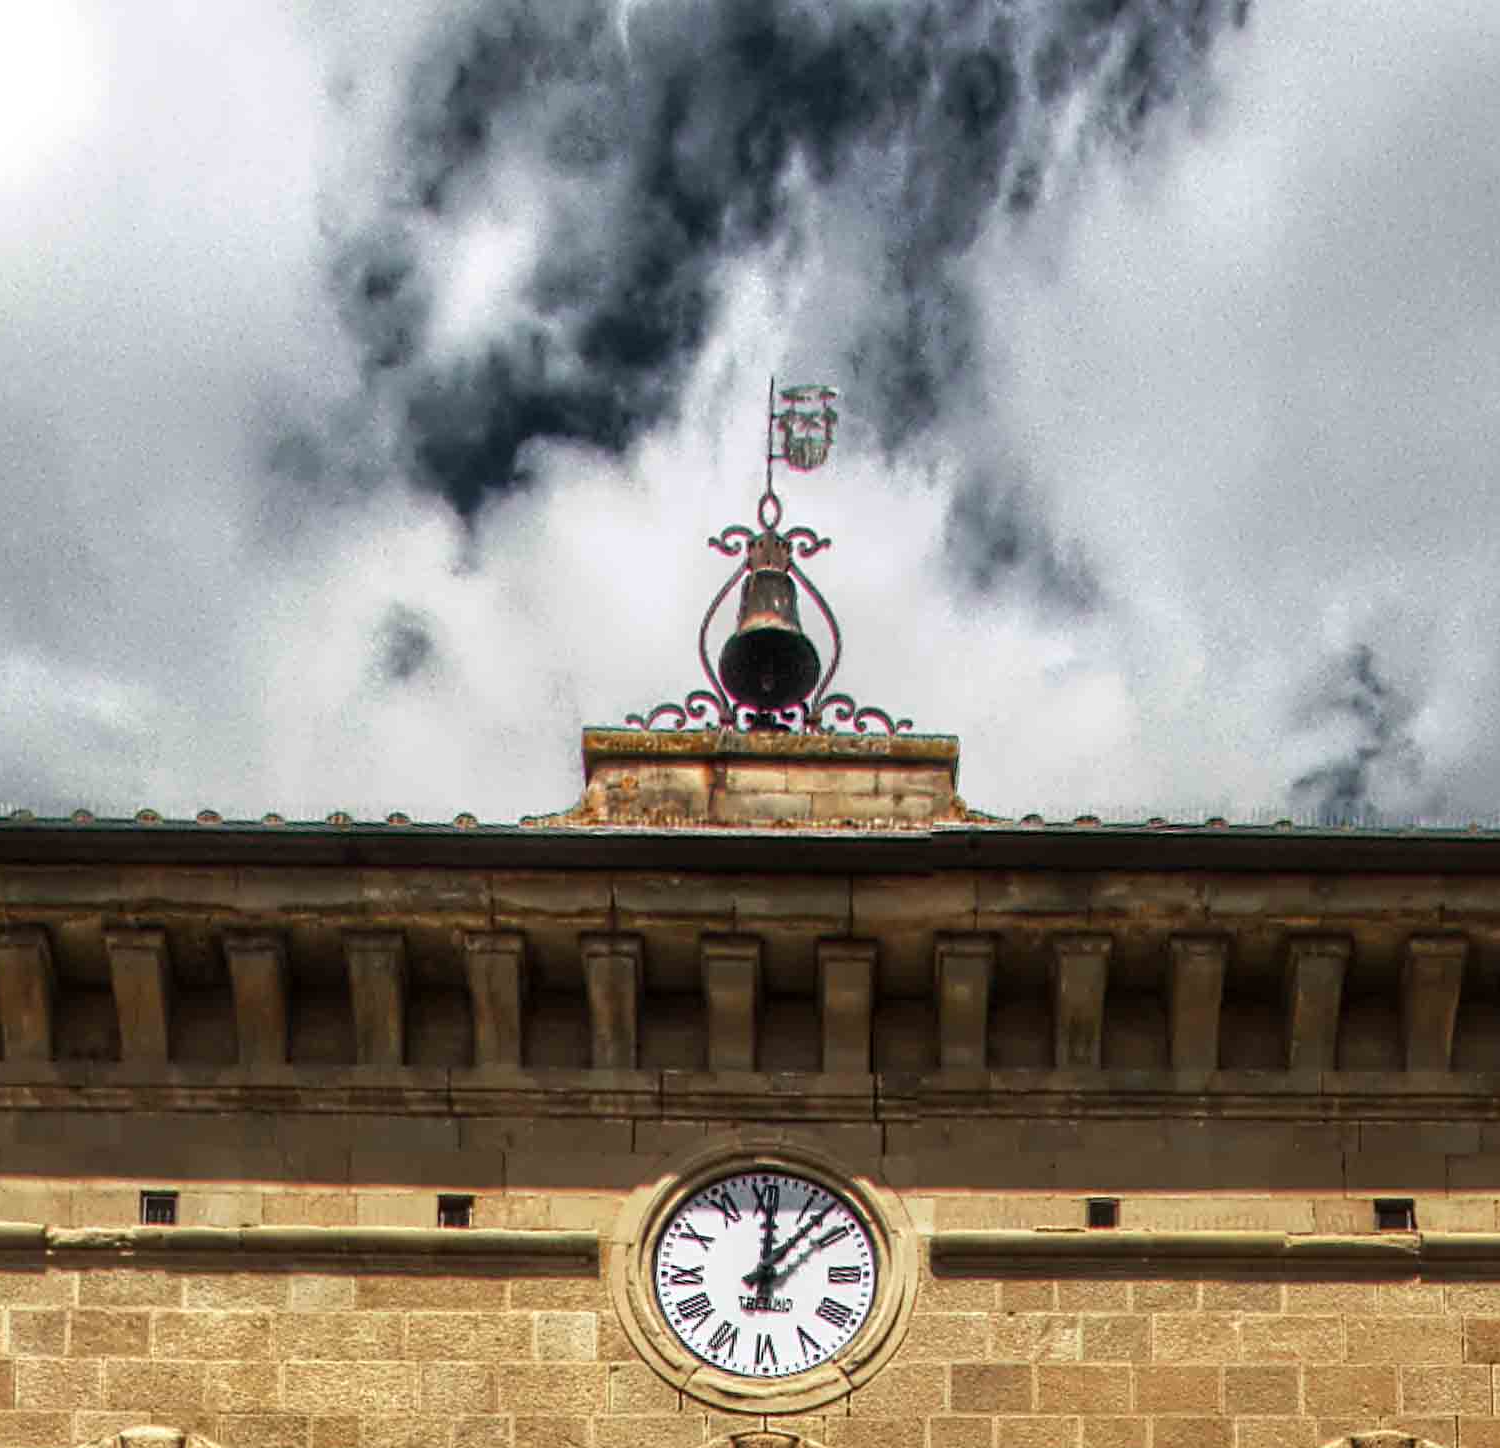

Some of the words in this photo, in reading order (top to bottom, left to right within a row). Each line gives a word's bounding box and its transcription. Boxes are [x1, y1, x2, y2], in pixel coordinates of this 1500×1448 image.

[678, 1222, 716, 1251] X
[669, 1265, 705, 1285] IX
[827, 1265, 862, 1284] III
[754, 1332, 778, 1365] VI
[797, 1324, 822, 1360] V
